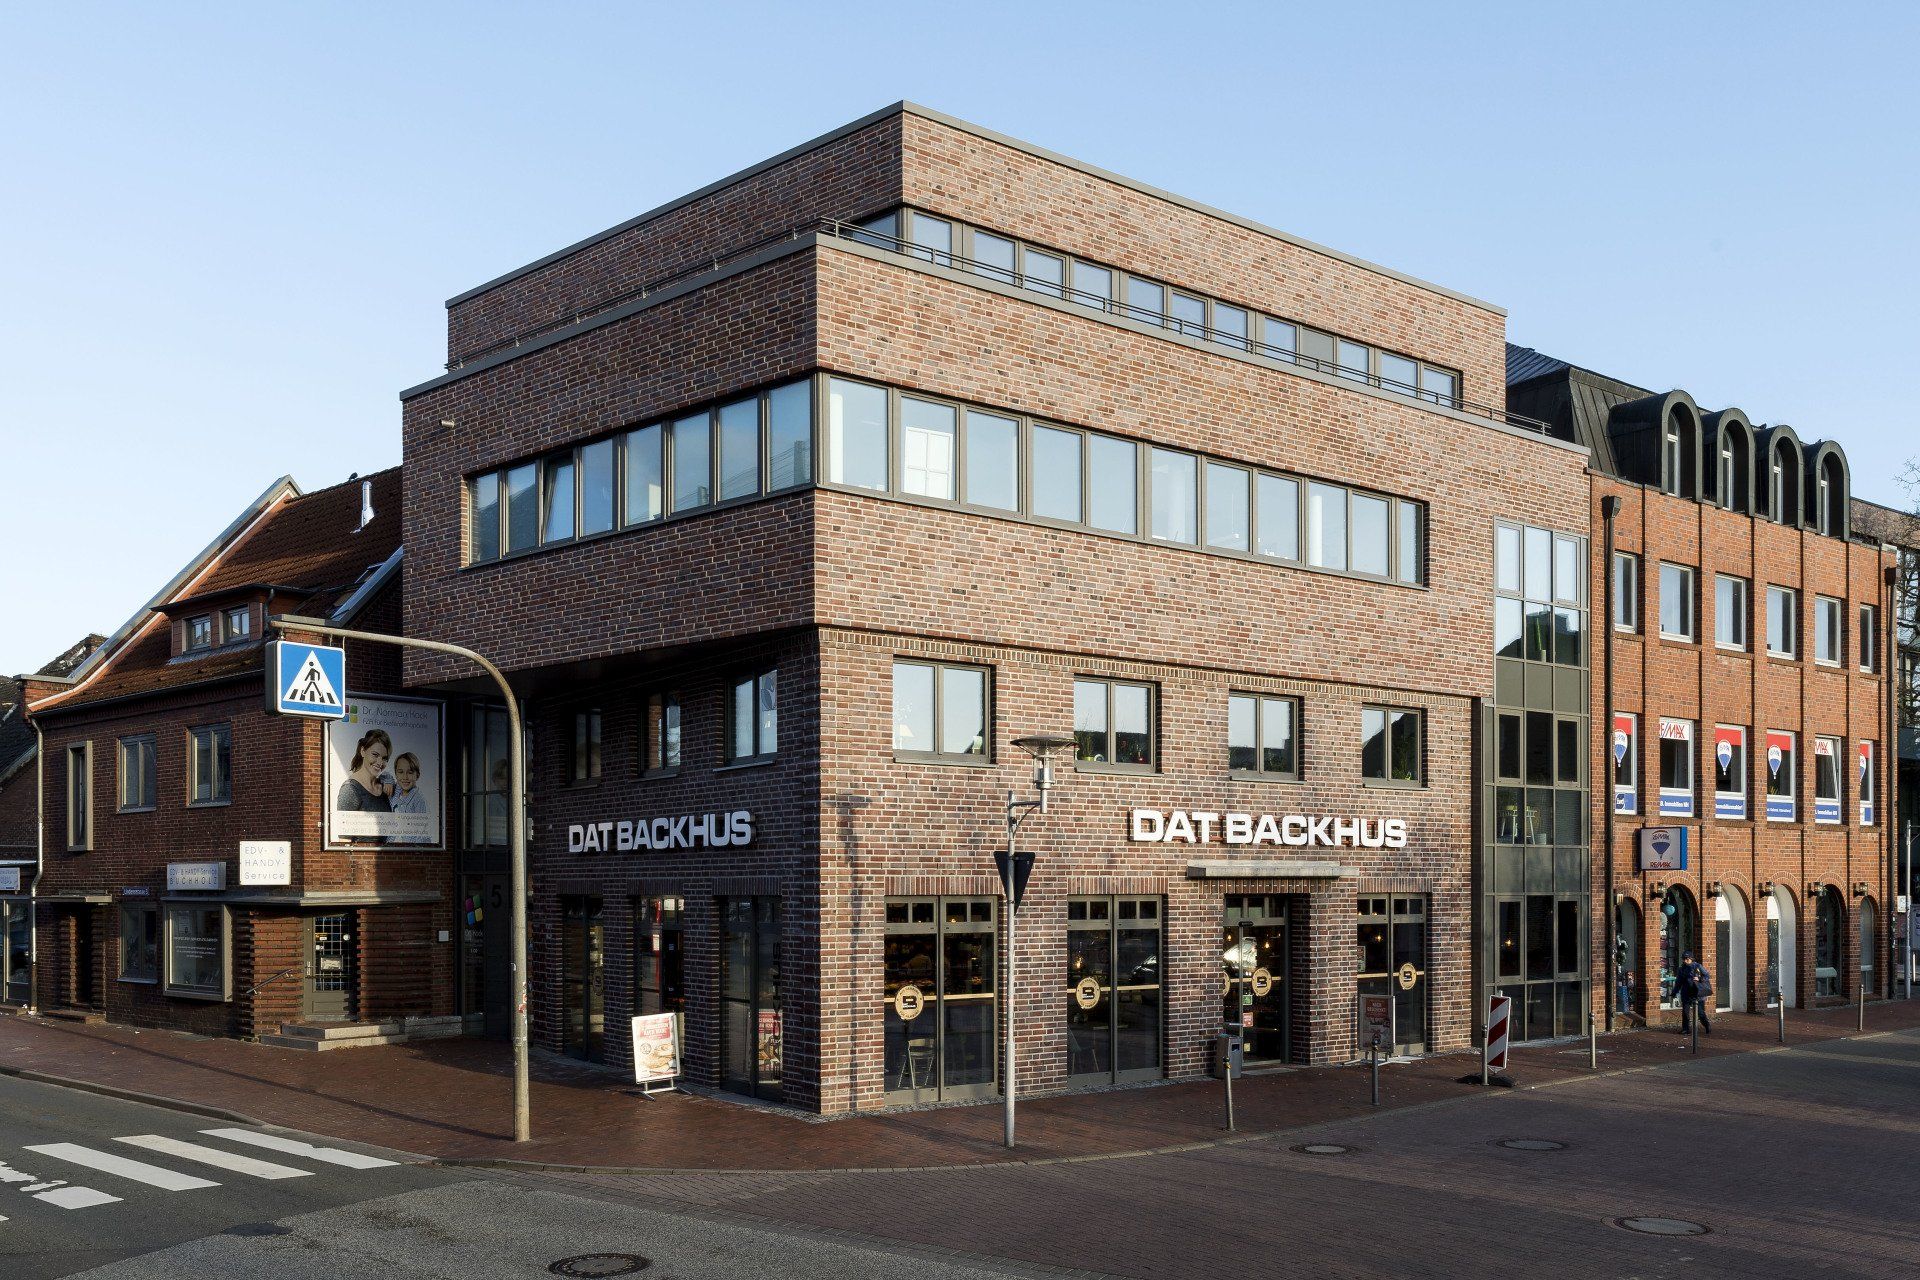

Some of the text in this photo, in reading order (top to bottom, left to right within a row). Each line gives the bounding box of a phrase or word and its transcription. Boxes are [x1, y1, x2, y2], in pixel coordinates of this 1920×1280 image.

[569, 811, 752, 852] DAT BACKHUS
[1132, 809, 1407, 848] DAT BACKHUS
[244, 846, 285, 855] EDV- &
[244, 859, 286, 867] HANDY-
[244, 871, 286, 880] Service
[170, 876, 217, 885] BUCHHOLZ
[490, 884, 503, 909] 5
